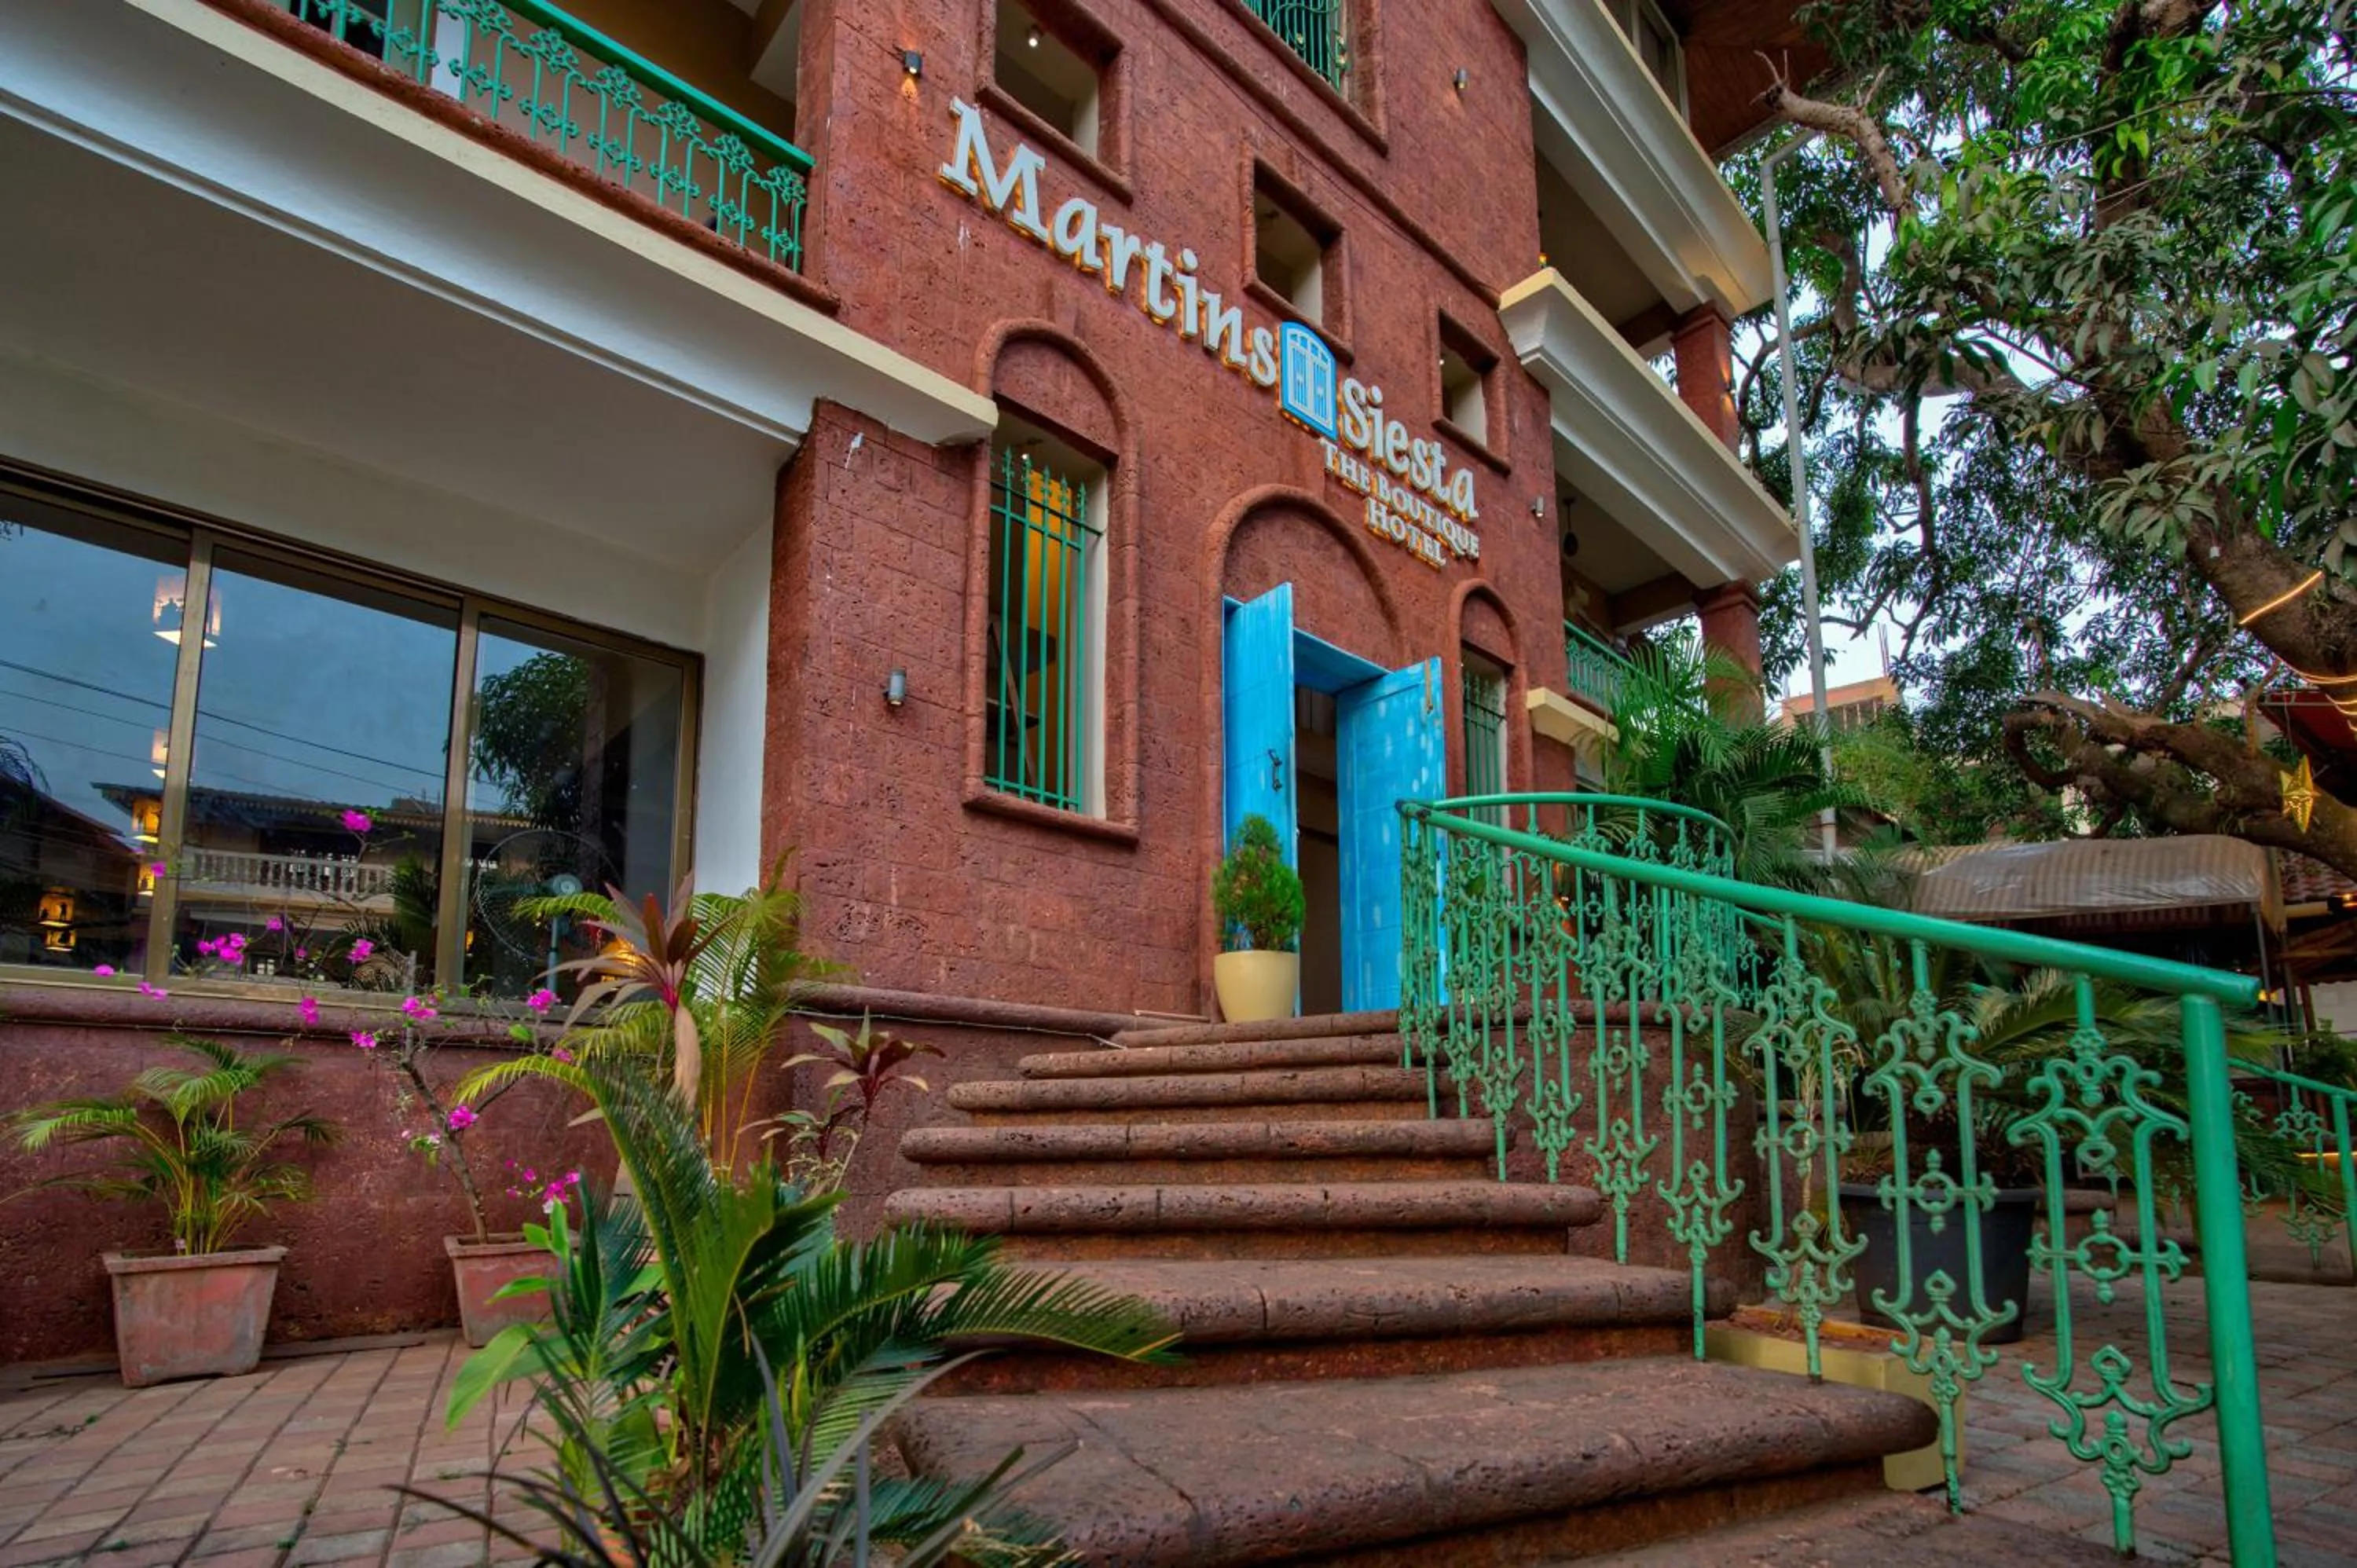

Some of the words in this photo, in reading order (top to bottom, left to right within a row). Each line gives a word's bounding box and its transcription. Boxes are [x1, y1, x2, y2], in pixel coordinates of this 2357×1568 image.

[940, 96, 1277, 387] Martins
[1340, 377, 1479, 520] Siesta
[1319, 437, 1370, 493] THE
[1376, 471, 1480, 559] BOUTIQUE
[1367, 496, 1446, 566] HOTEL
